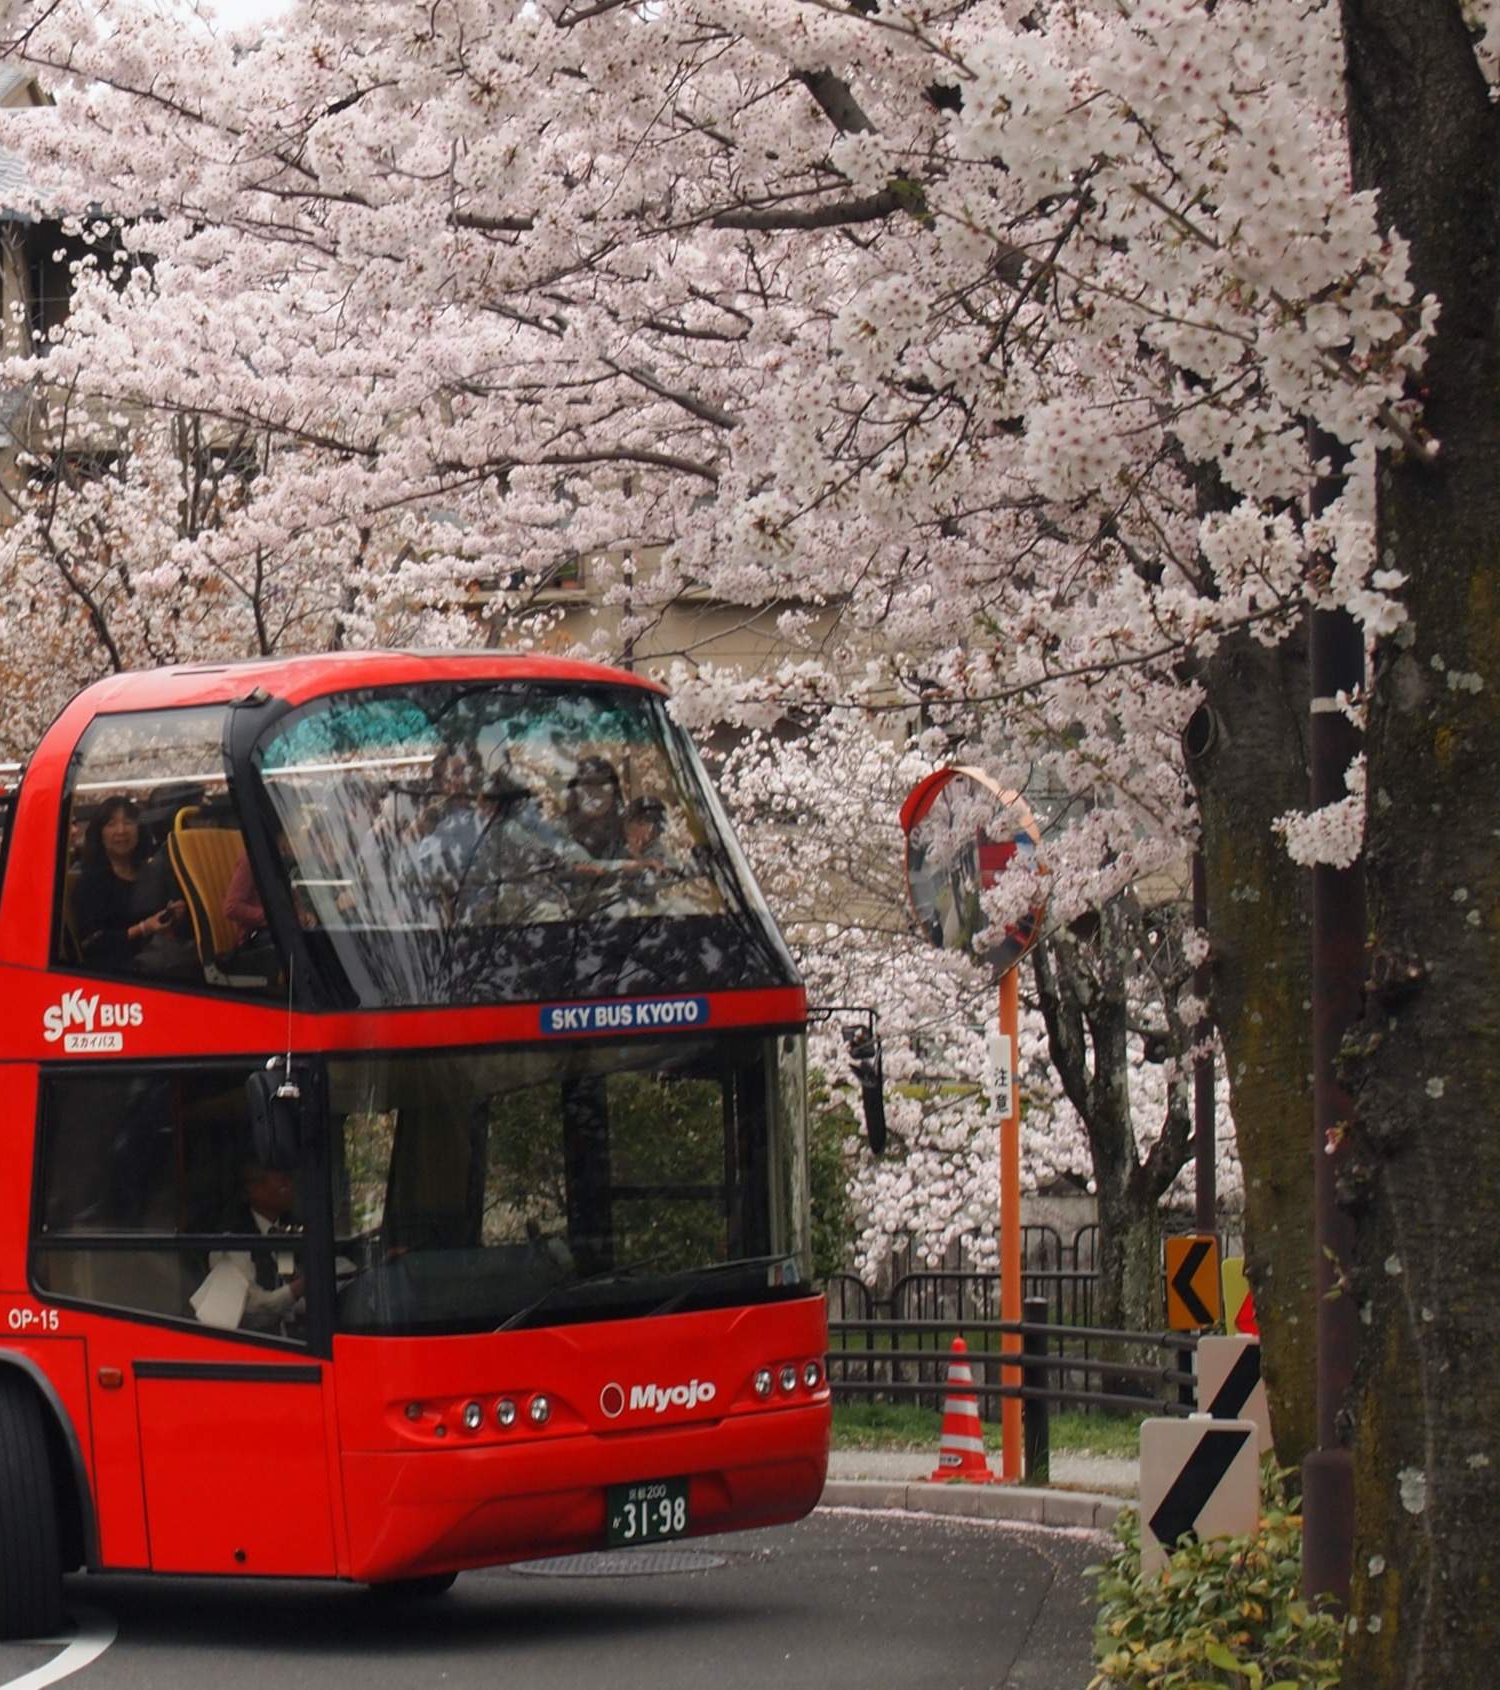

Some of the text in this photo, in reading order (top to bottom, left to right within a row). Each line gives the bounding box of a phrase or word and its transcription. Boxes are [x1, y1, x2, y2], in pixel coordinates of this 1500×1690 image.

[43, 988, 143, 1042] SKY BUS
[552, 1000, 698, 1029] SKY BUS KYOTO
[995, 1066, 1009, 1113] 注意
[8, 1308, 60, 1331] OP-15
[629, 1379, 717, 1413] Myojo
